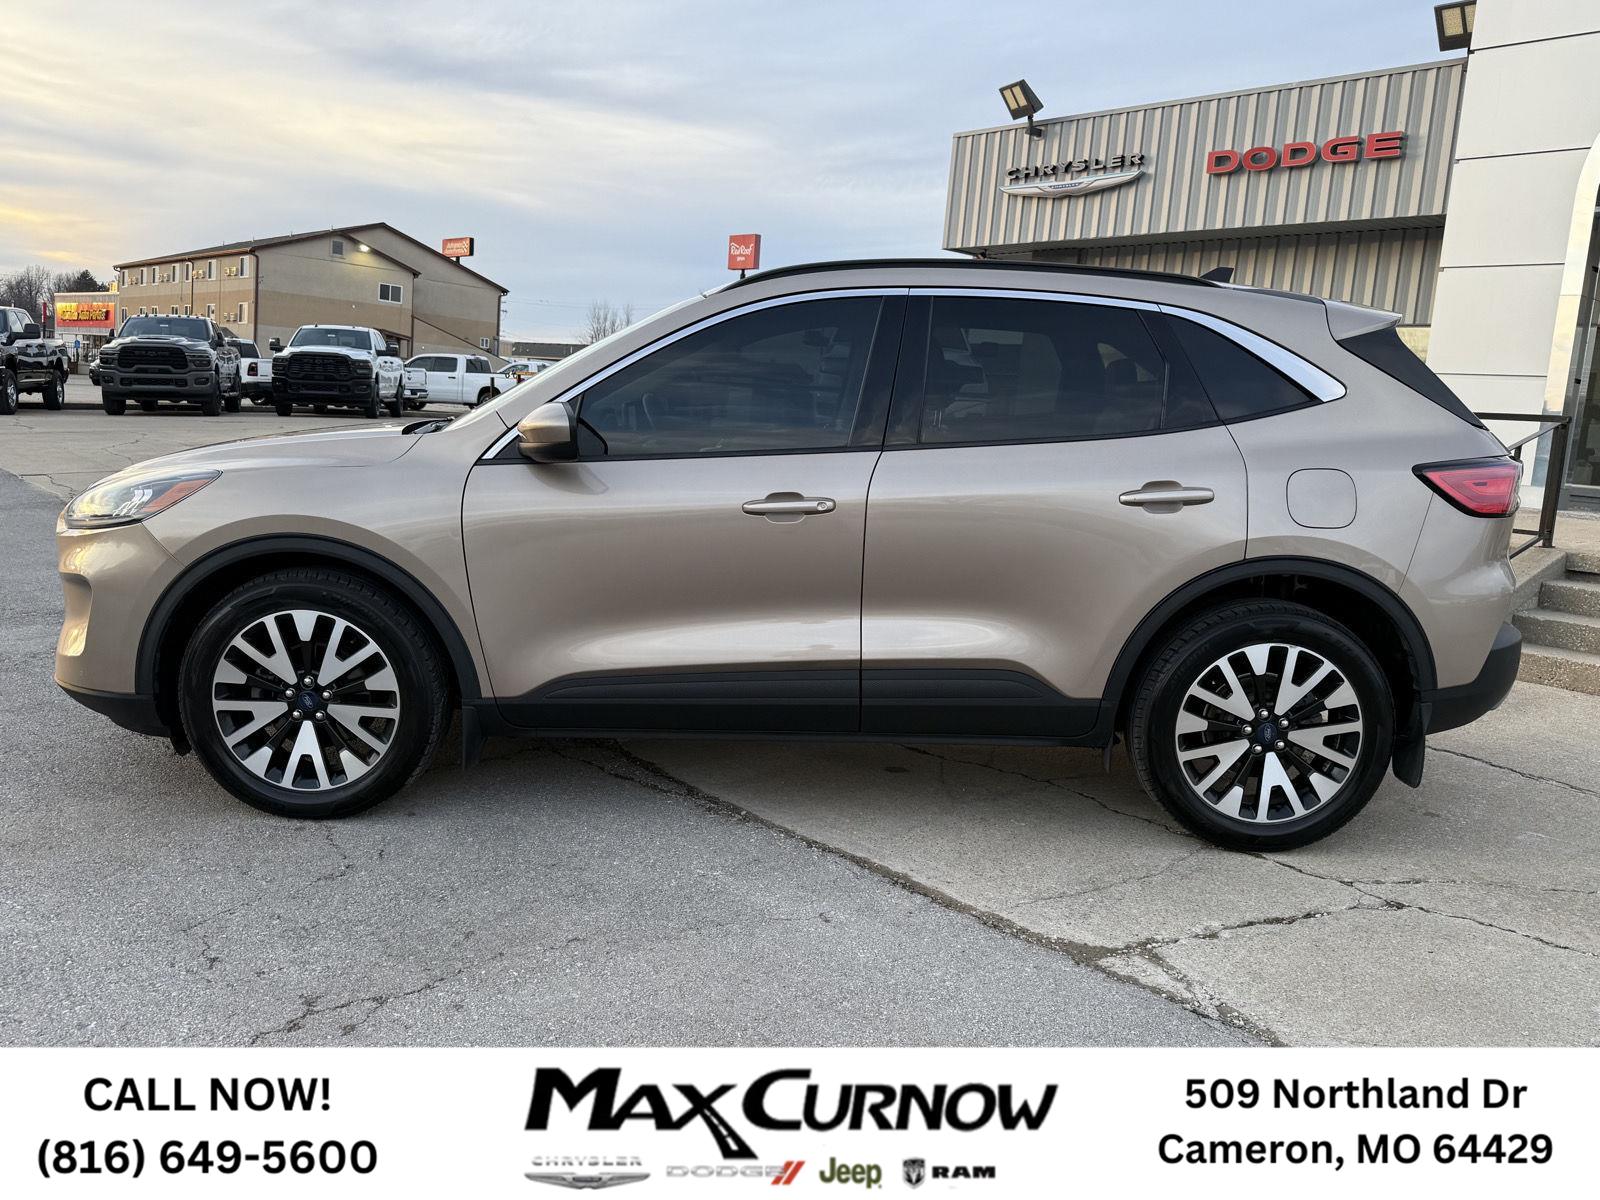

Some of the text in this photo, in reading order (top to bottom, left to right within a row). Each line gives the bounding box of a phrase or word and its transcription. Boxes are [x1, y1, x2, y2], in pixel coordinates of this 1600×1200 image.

[1007, 152, 1144, 180] CHRYSLER
[1206, 131, 1406, 174] DODGE
[740, 243, 754, 255] Roof
